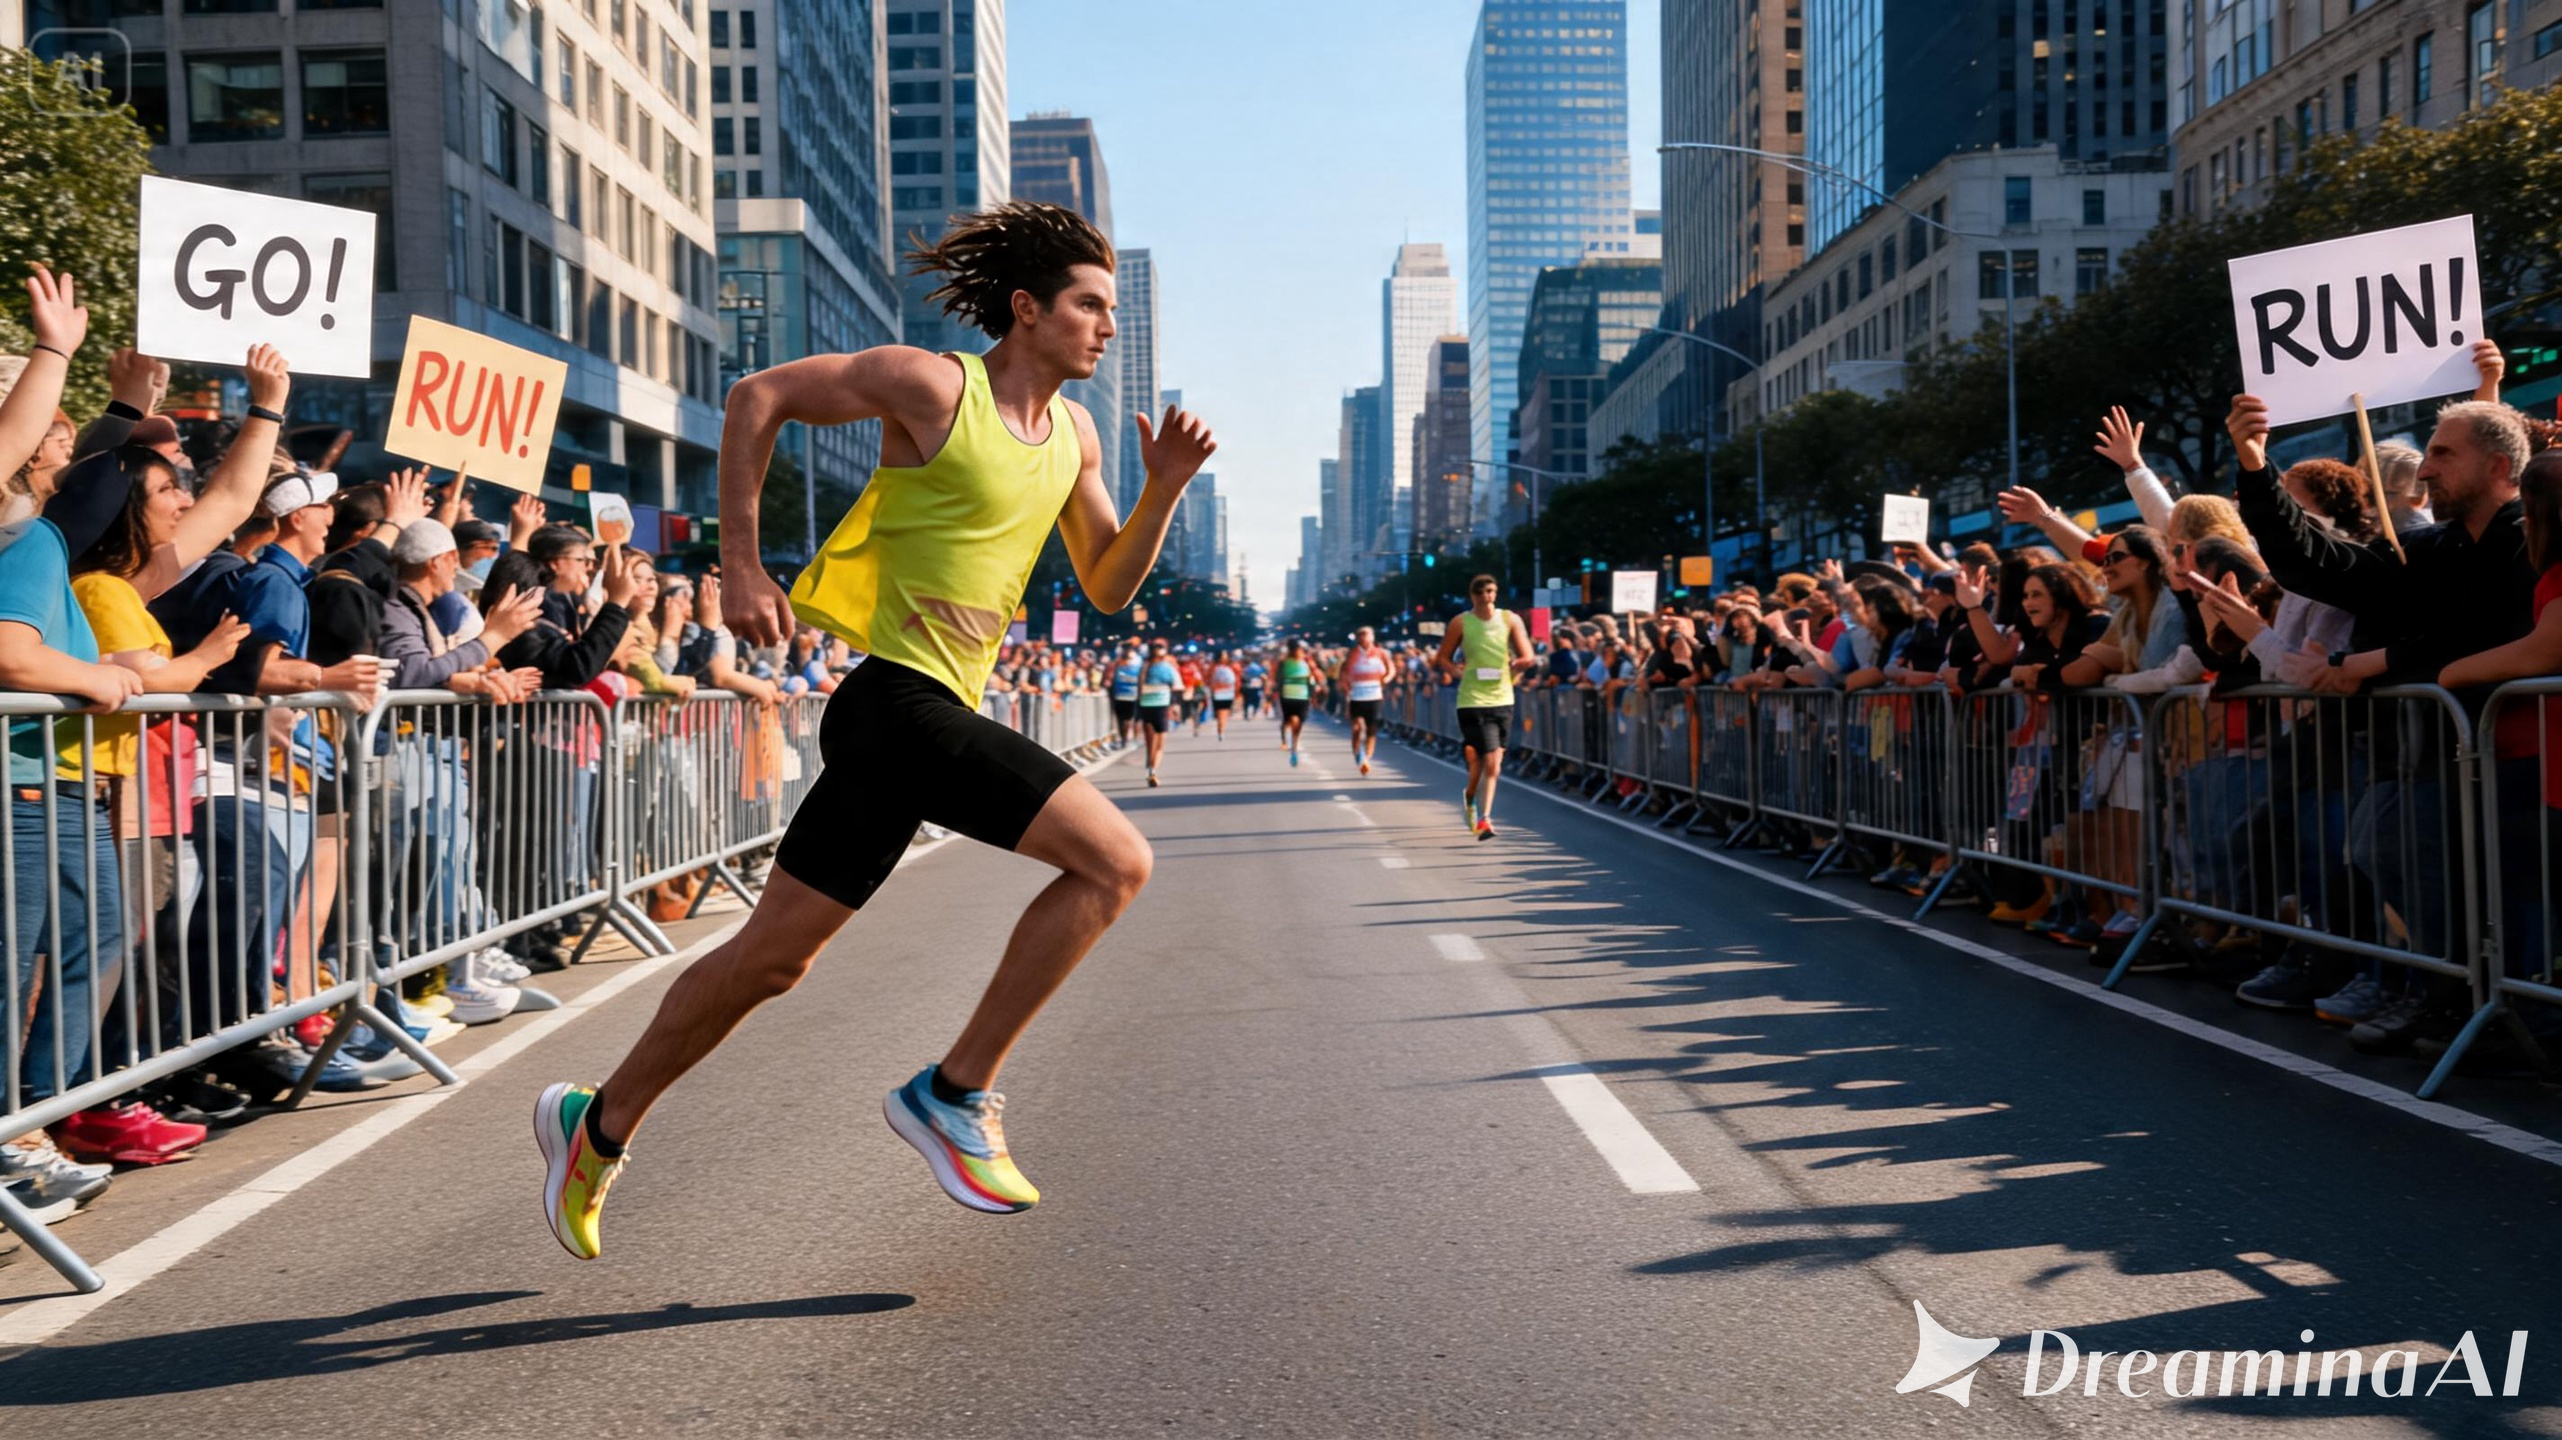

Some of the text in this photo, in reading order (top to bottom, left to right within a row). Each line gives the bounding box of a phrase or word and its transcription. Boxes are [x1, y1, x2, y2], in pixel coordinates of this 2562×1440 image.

[174, 223, 347, 330] GO!
[2251, 257, 2465, 376] RUN!
[406, 350, 545, 459] RUN!
